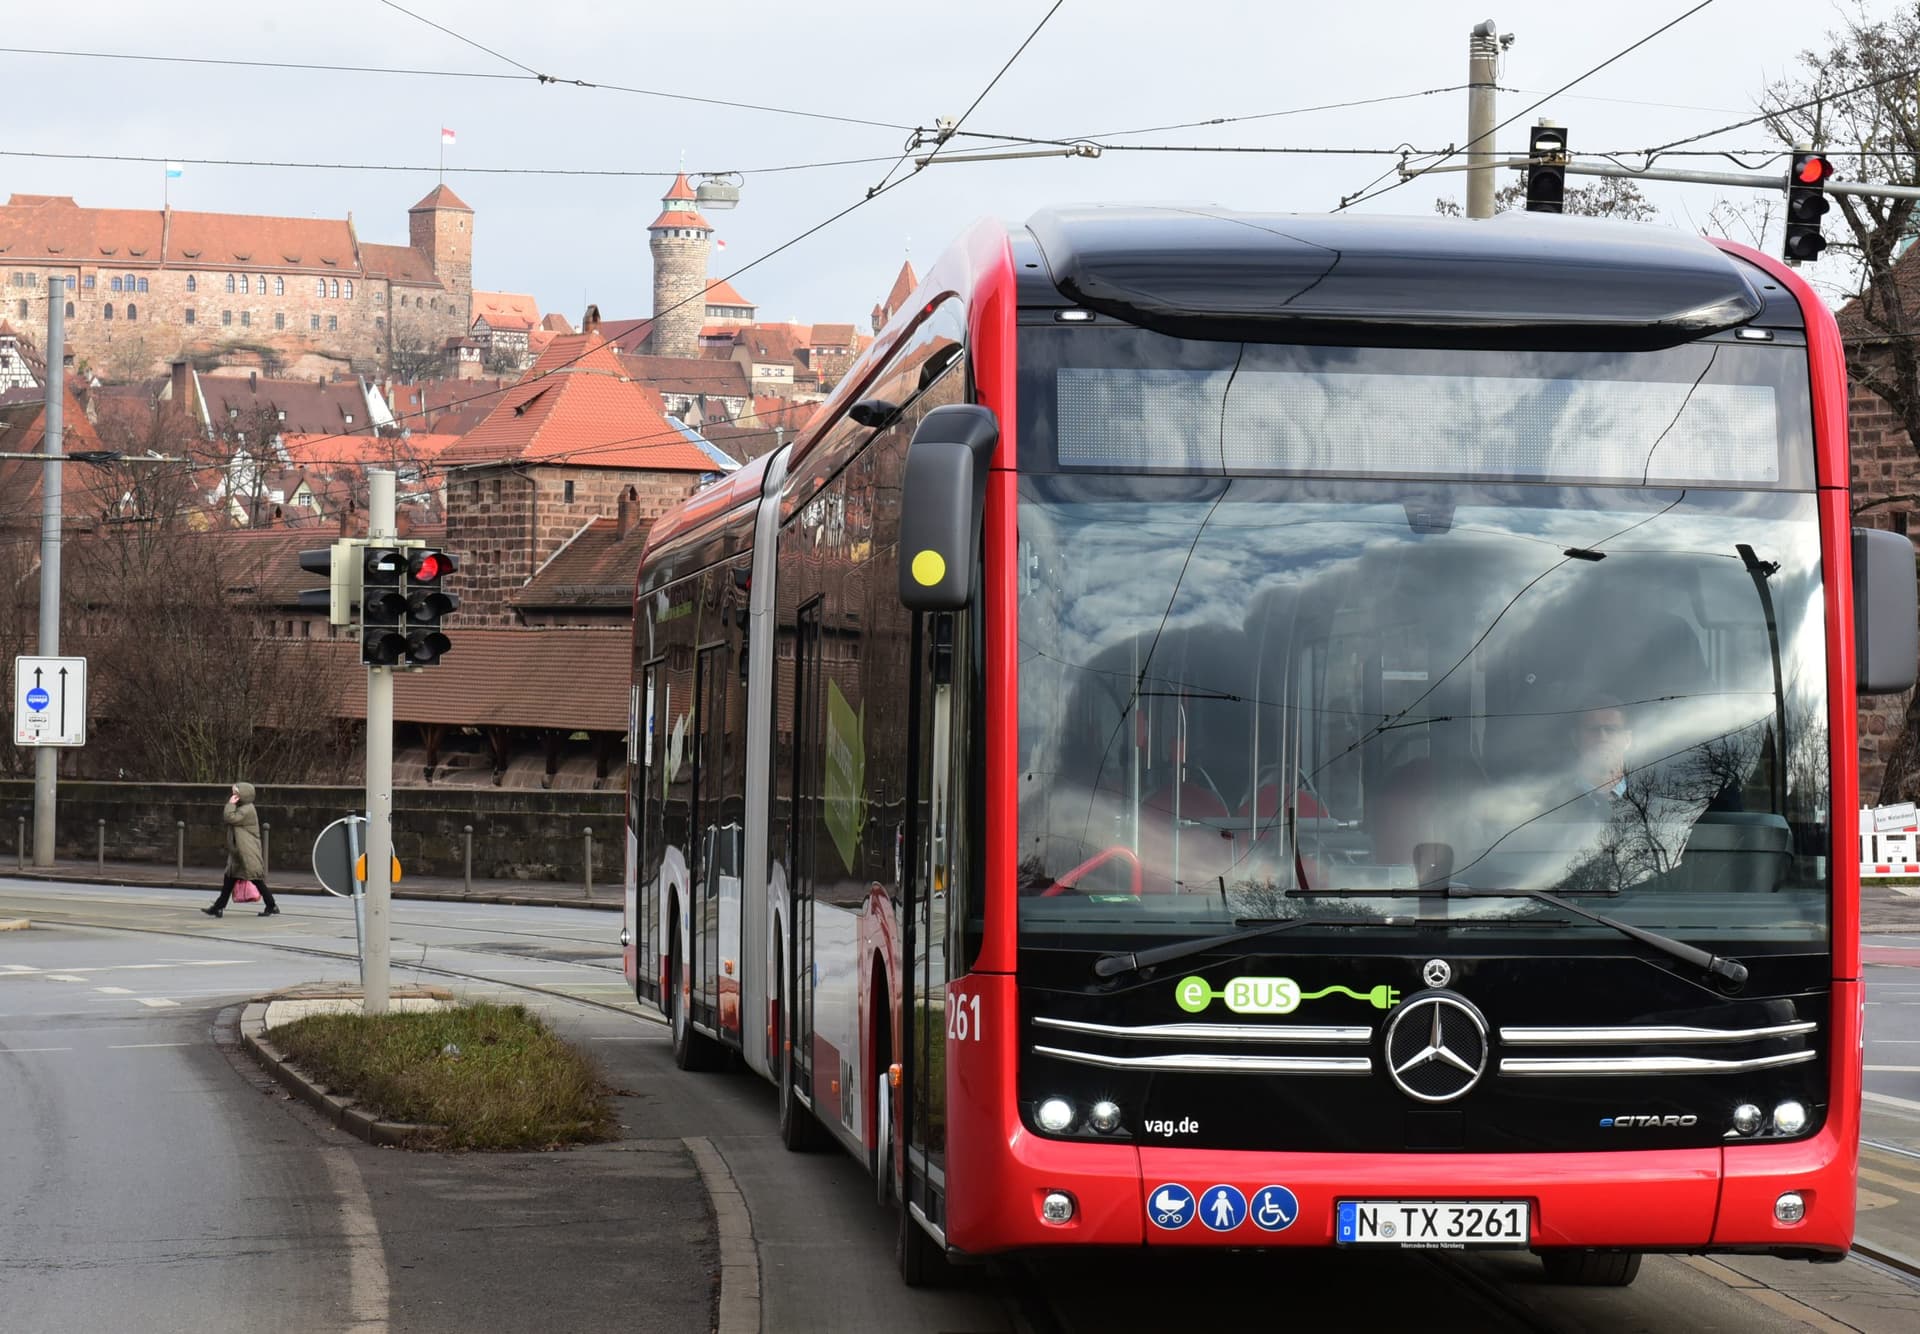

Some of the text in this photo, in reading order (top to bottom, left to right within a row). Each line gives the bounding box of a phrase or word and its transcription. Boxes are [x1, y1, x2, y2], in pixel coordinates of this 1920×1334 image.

[1184, 983, 1291, 1007] e BUS
[948, 992, 980, 1041] 261
[1144, 1116, 1199, 1137] vag.de
[1600, 1115, 1697, 1127] eCITARO
[1343, 1226, 1351, 1236] D
[1359, 1208, 1521, 1237] N TX 3261
